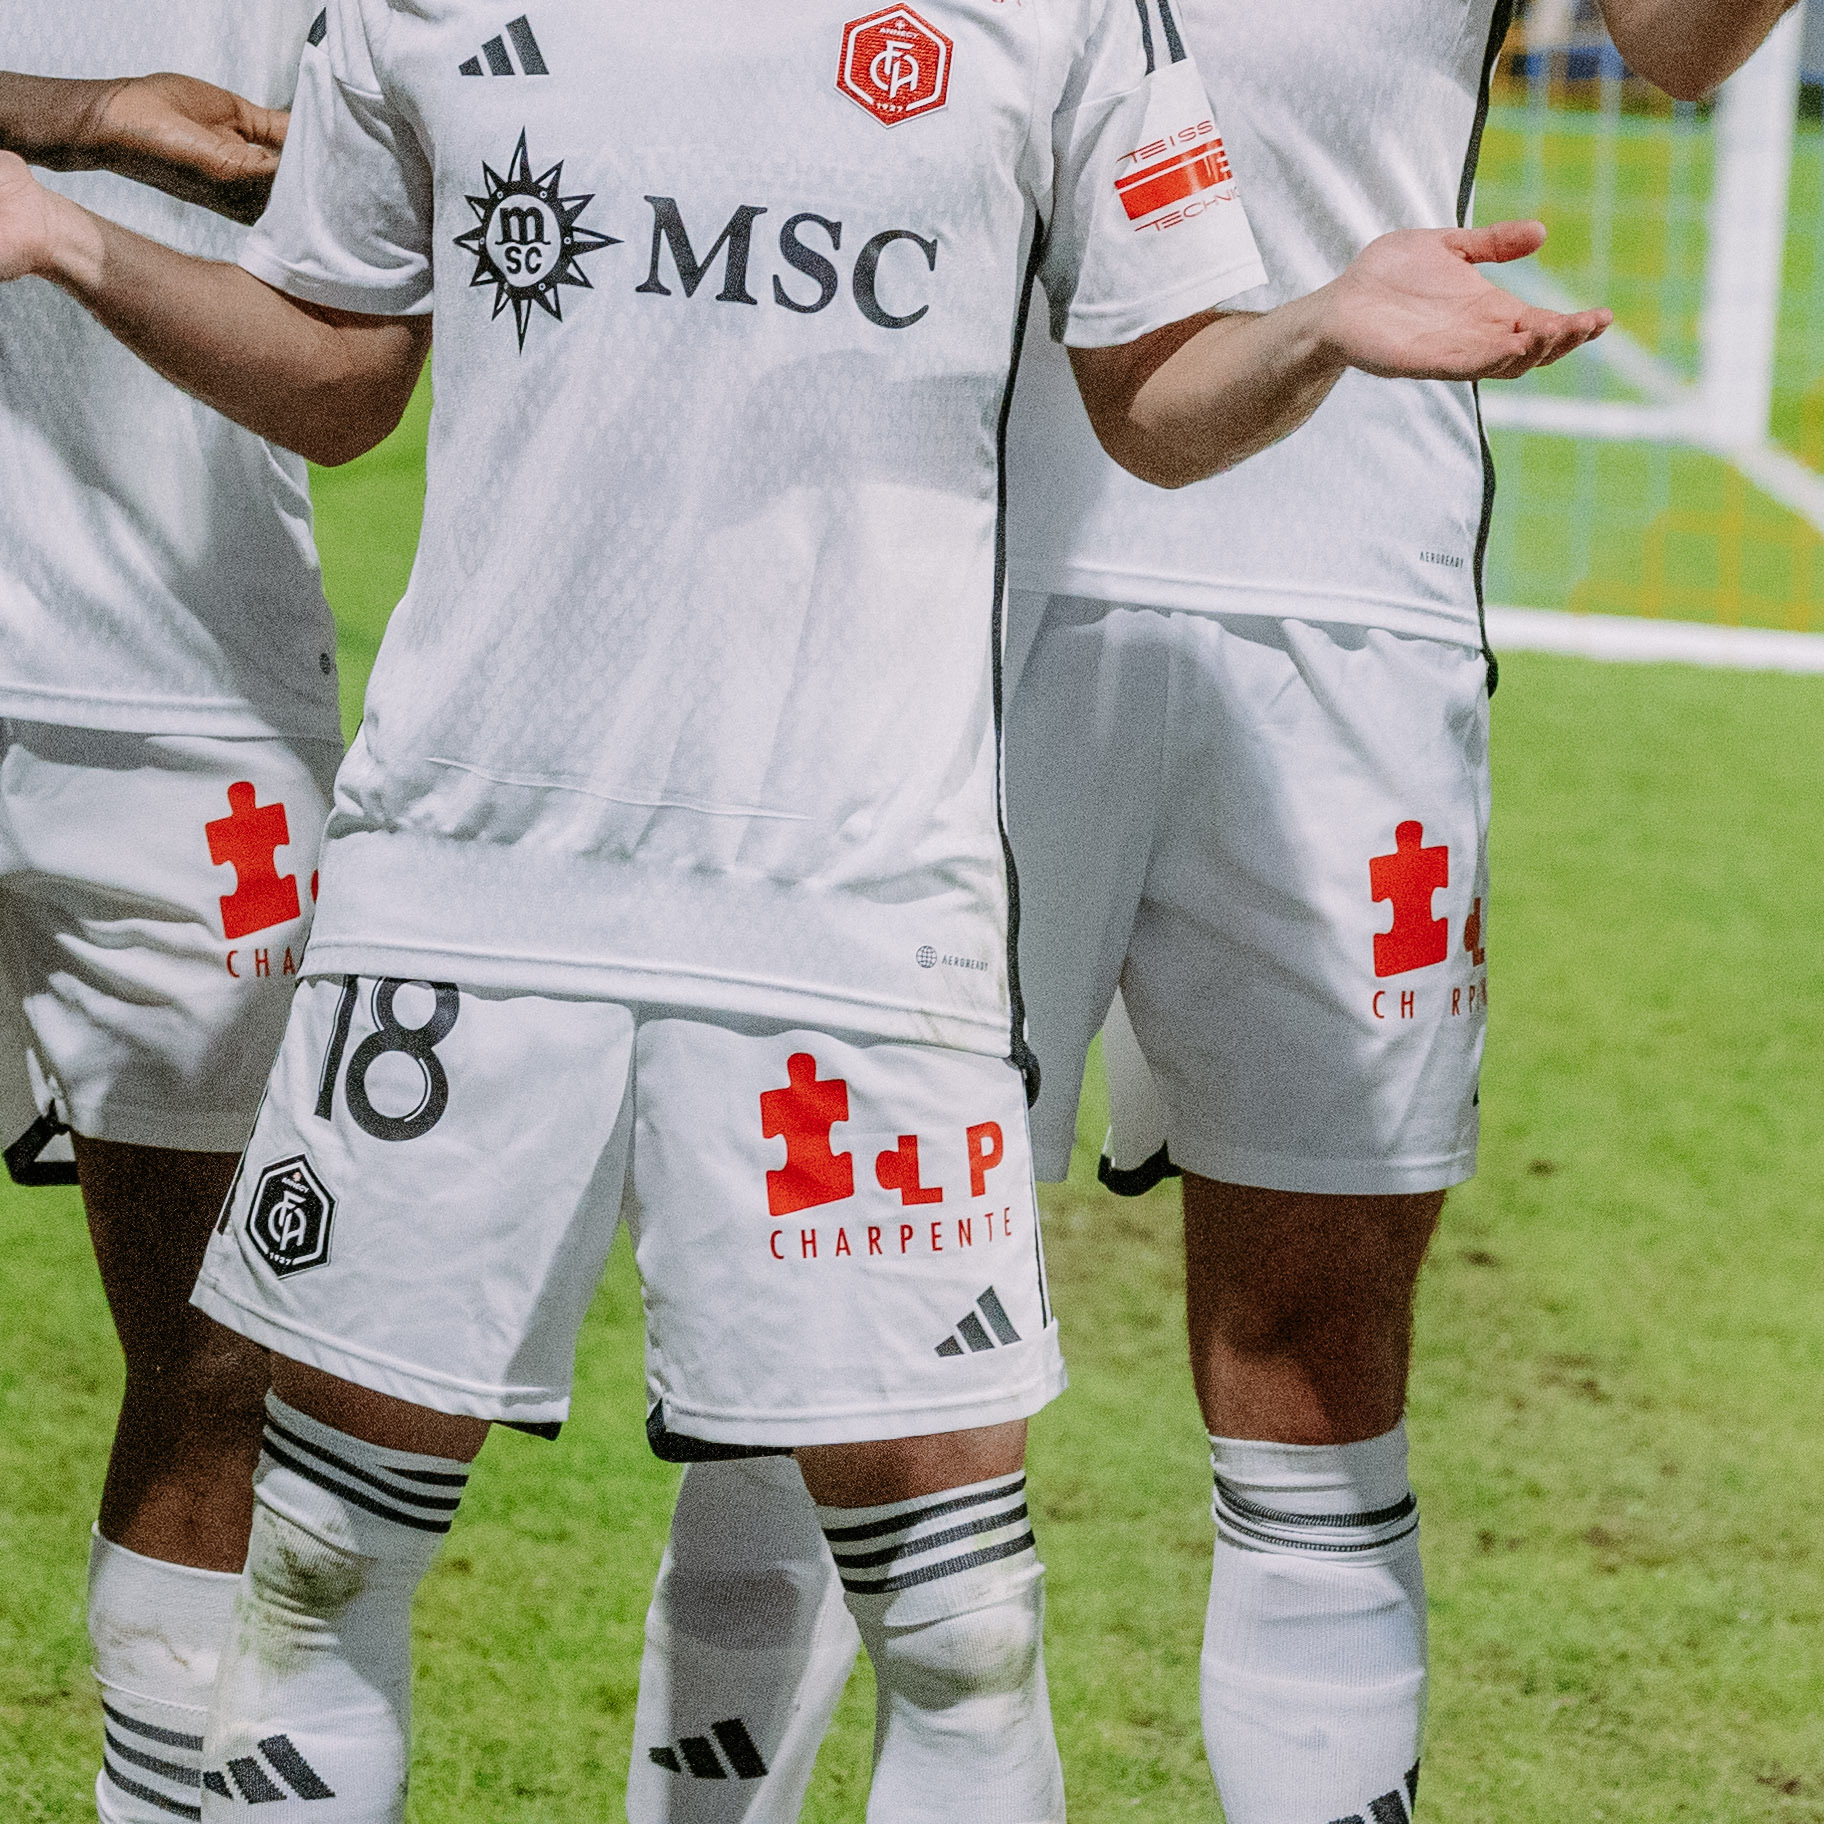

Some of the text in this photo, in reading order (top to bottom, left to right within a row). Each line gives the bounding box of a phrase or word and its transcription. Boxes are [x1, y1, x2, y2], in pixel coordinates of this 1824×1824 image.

[635, 196, 939, 330] MSC
[314, 974, 460, 1141] 18
[769, 1207, 1012, 1260] CHARPENTE
